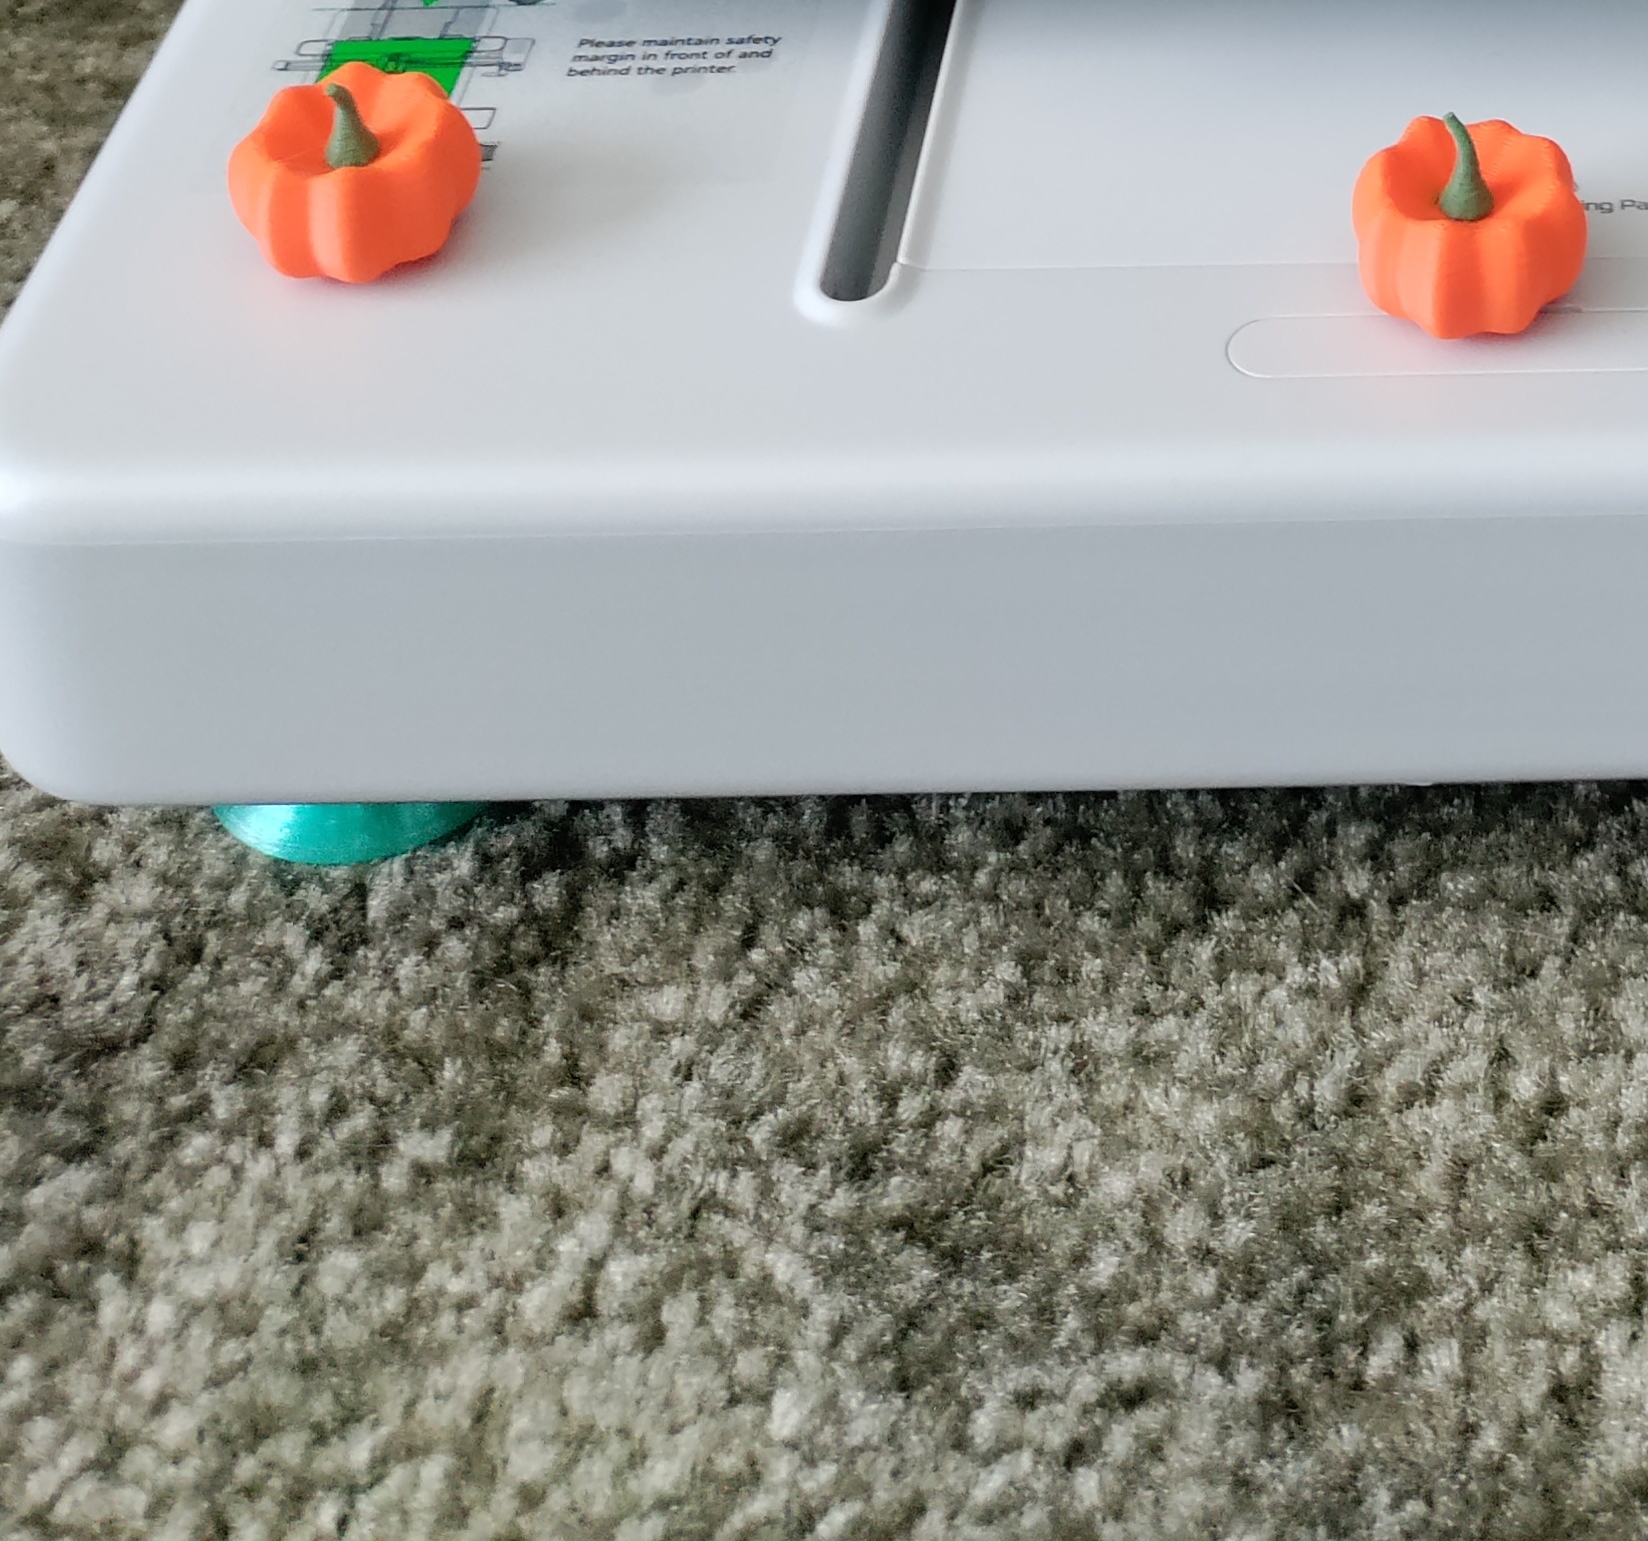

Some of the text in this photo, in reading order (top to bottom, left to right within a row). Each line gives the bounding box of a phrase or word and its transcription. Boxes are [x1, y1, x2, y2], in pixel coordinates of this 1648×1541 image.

[577, 34, 782, 48] Please maintain safety
[571, 48, 774, 64] margin in front of and
[566, 66, 631, 76] behind
[637, 65, 666, 75] the
[1581, 200, 1614, 214] ing
